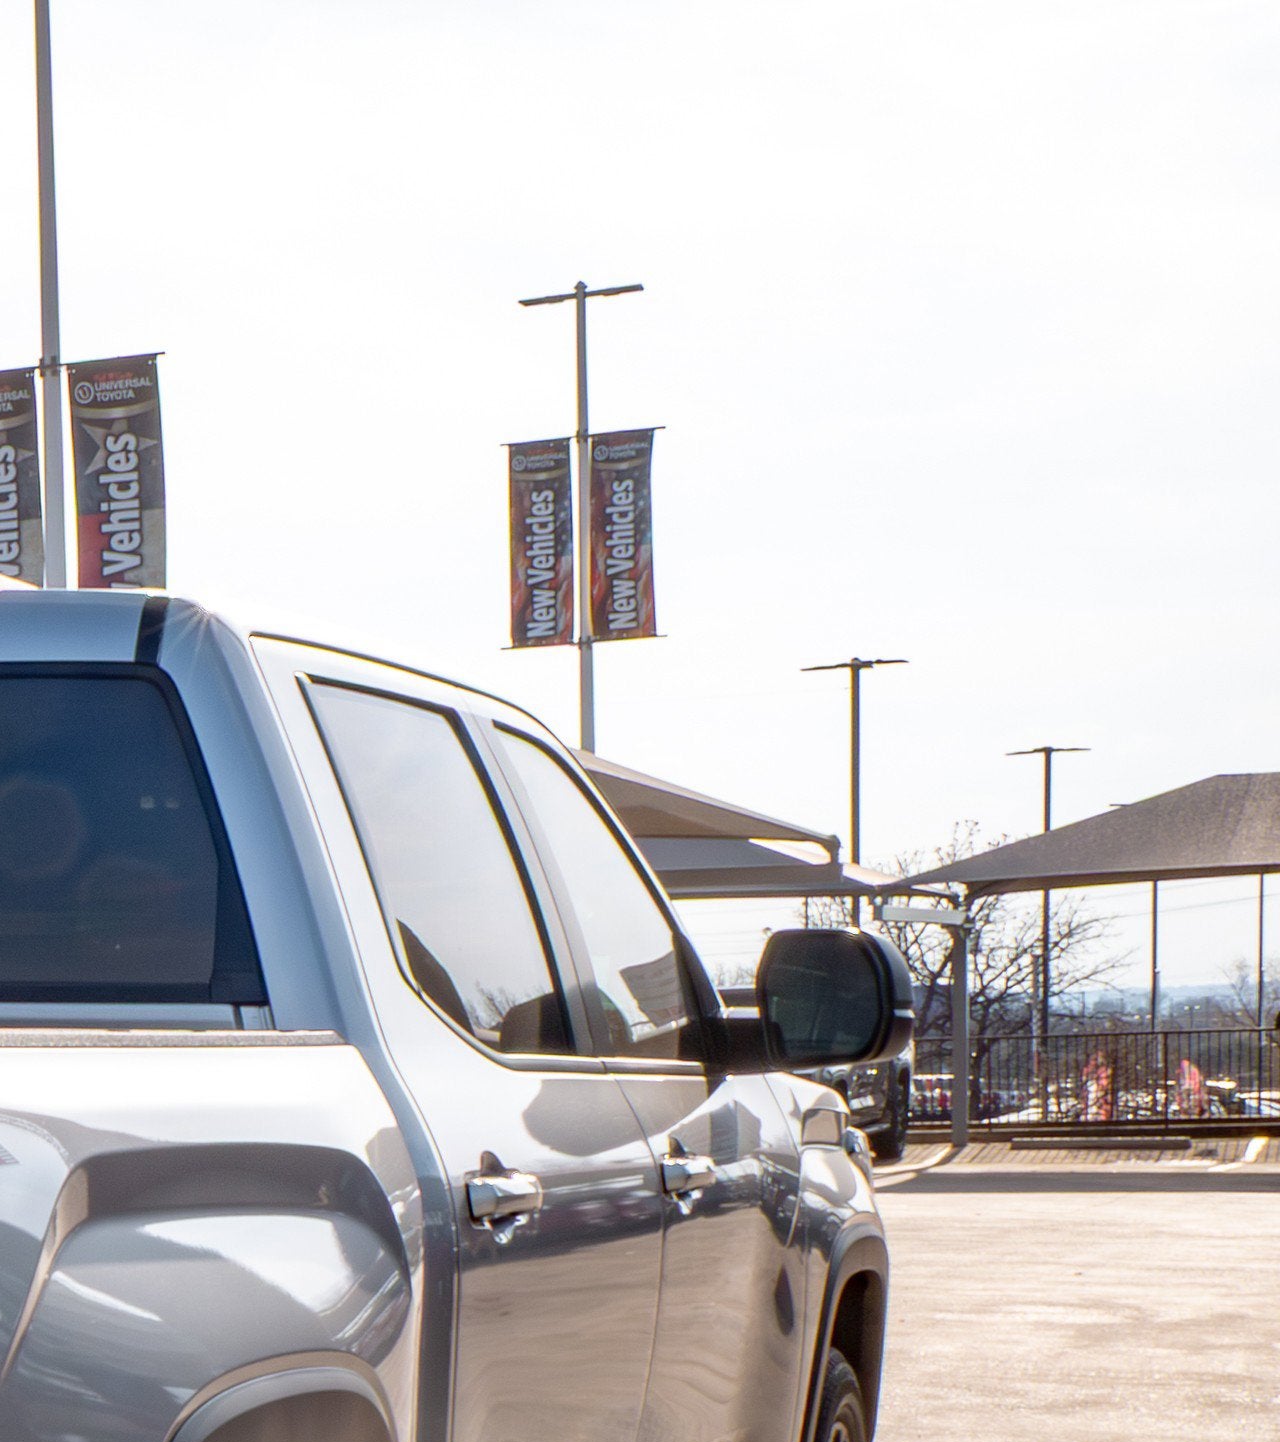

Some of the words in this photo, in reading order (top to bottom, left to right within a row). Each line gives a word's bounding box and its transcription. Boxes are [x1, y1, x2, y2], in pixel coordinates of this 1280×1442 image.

[94, 377, 153, 391] UNIVERSAL
[95, 389, 136, 402] TOYOTA
[98, 432, 142, 577] Vehicles
[605, 478, 635, 576] Vehicles
[525, 489, 555, 587] Vehicles
[526, 590, 556, 638] New
[608, 579, 638, 630] New
